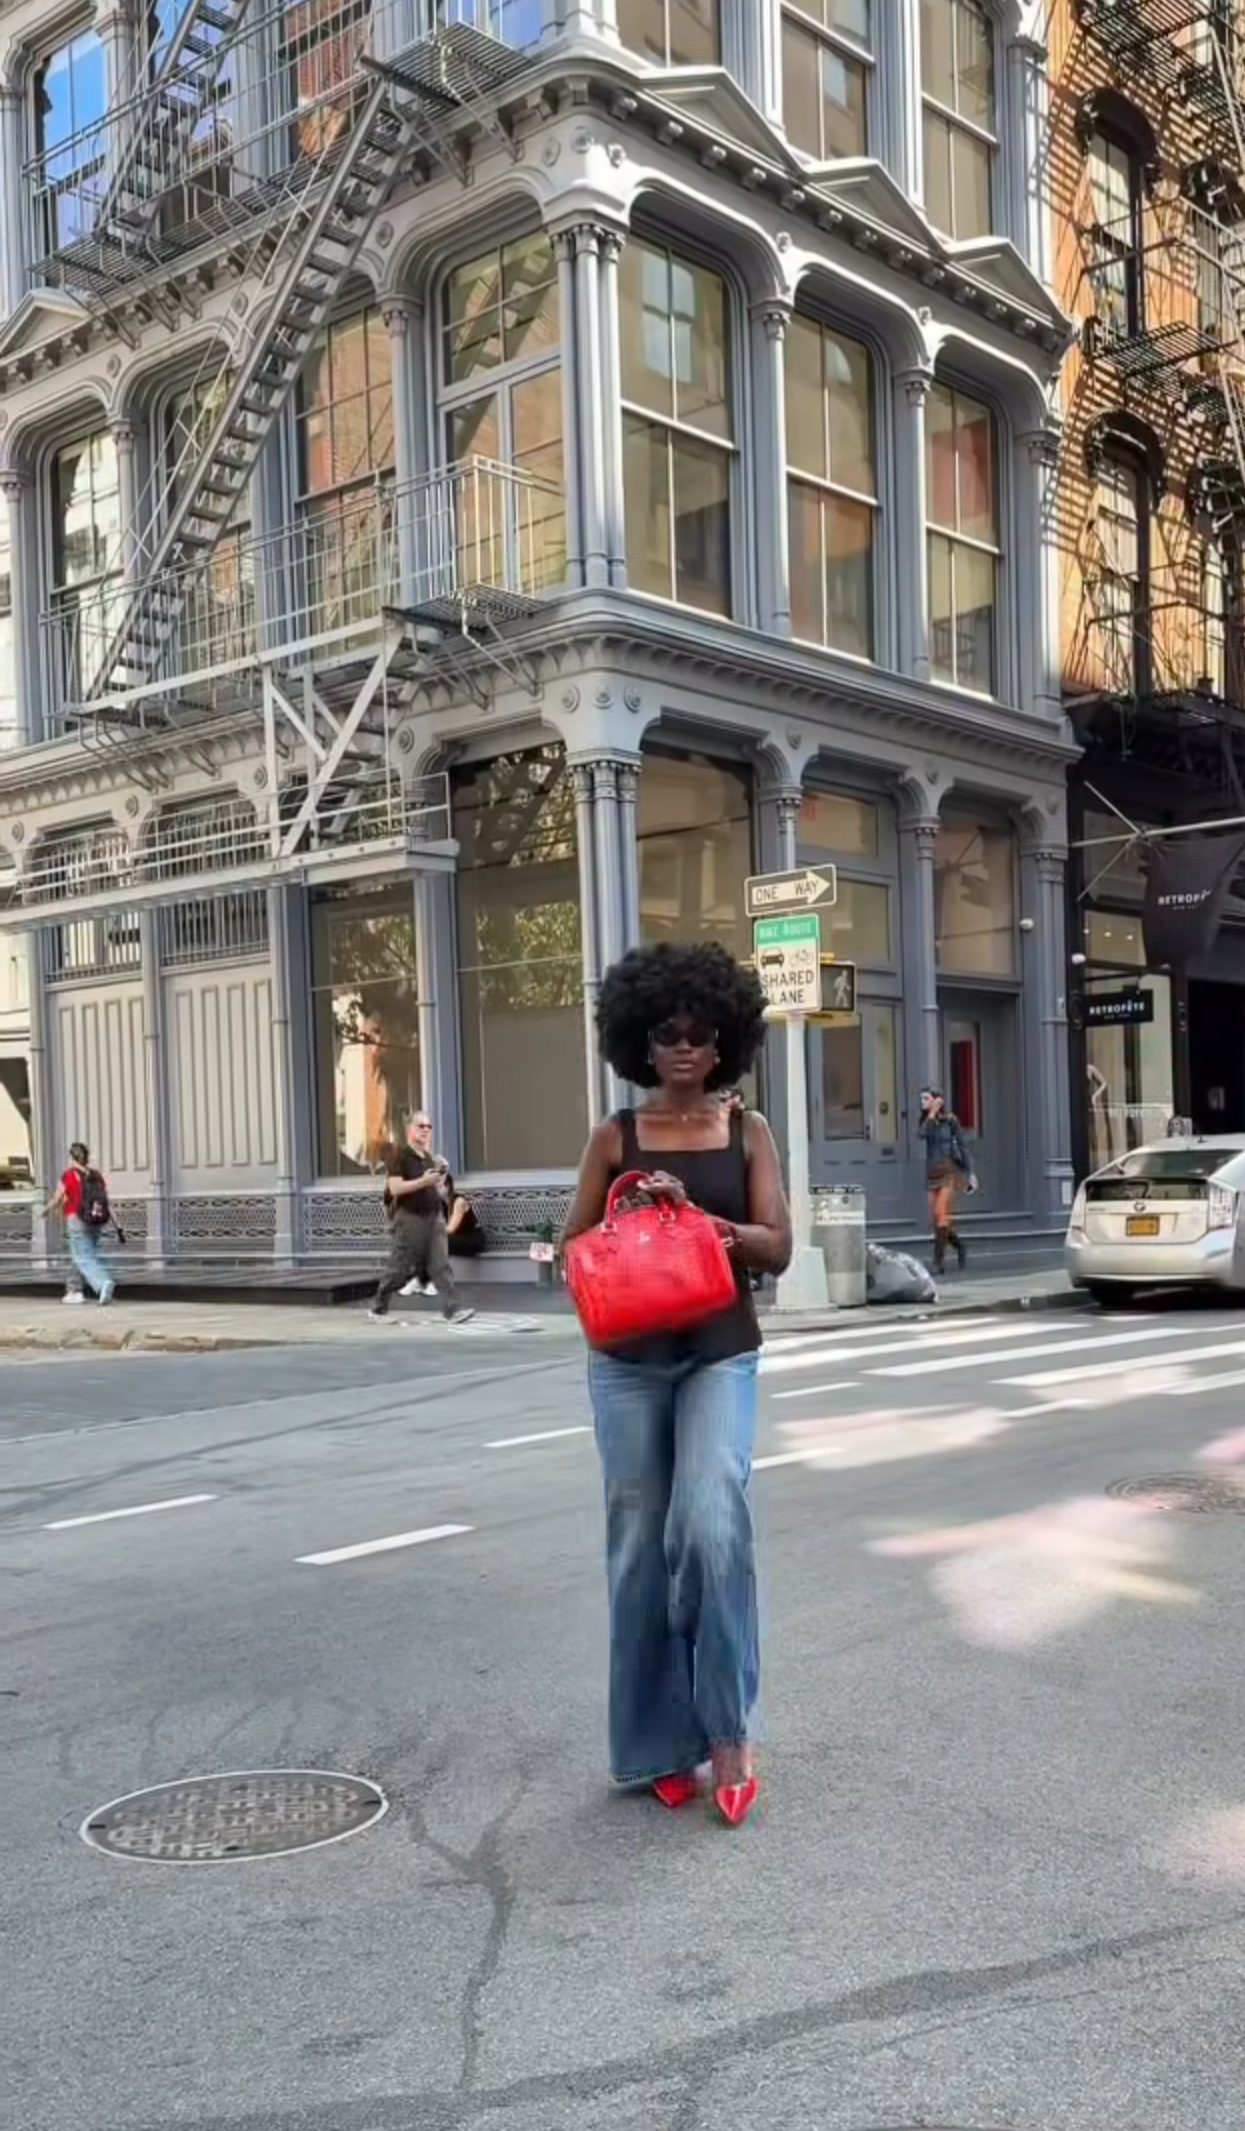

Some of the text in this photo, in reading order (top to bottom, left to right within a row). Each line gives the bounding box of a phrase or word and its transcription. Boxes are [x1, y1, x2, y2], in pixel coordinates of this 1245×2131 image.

[756, 879, 818, 903] ONE WAY
[763, 970, 814, 987] SHARED
[770, 988, 804, 1005] LANE
